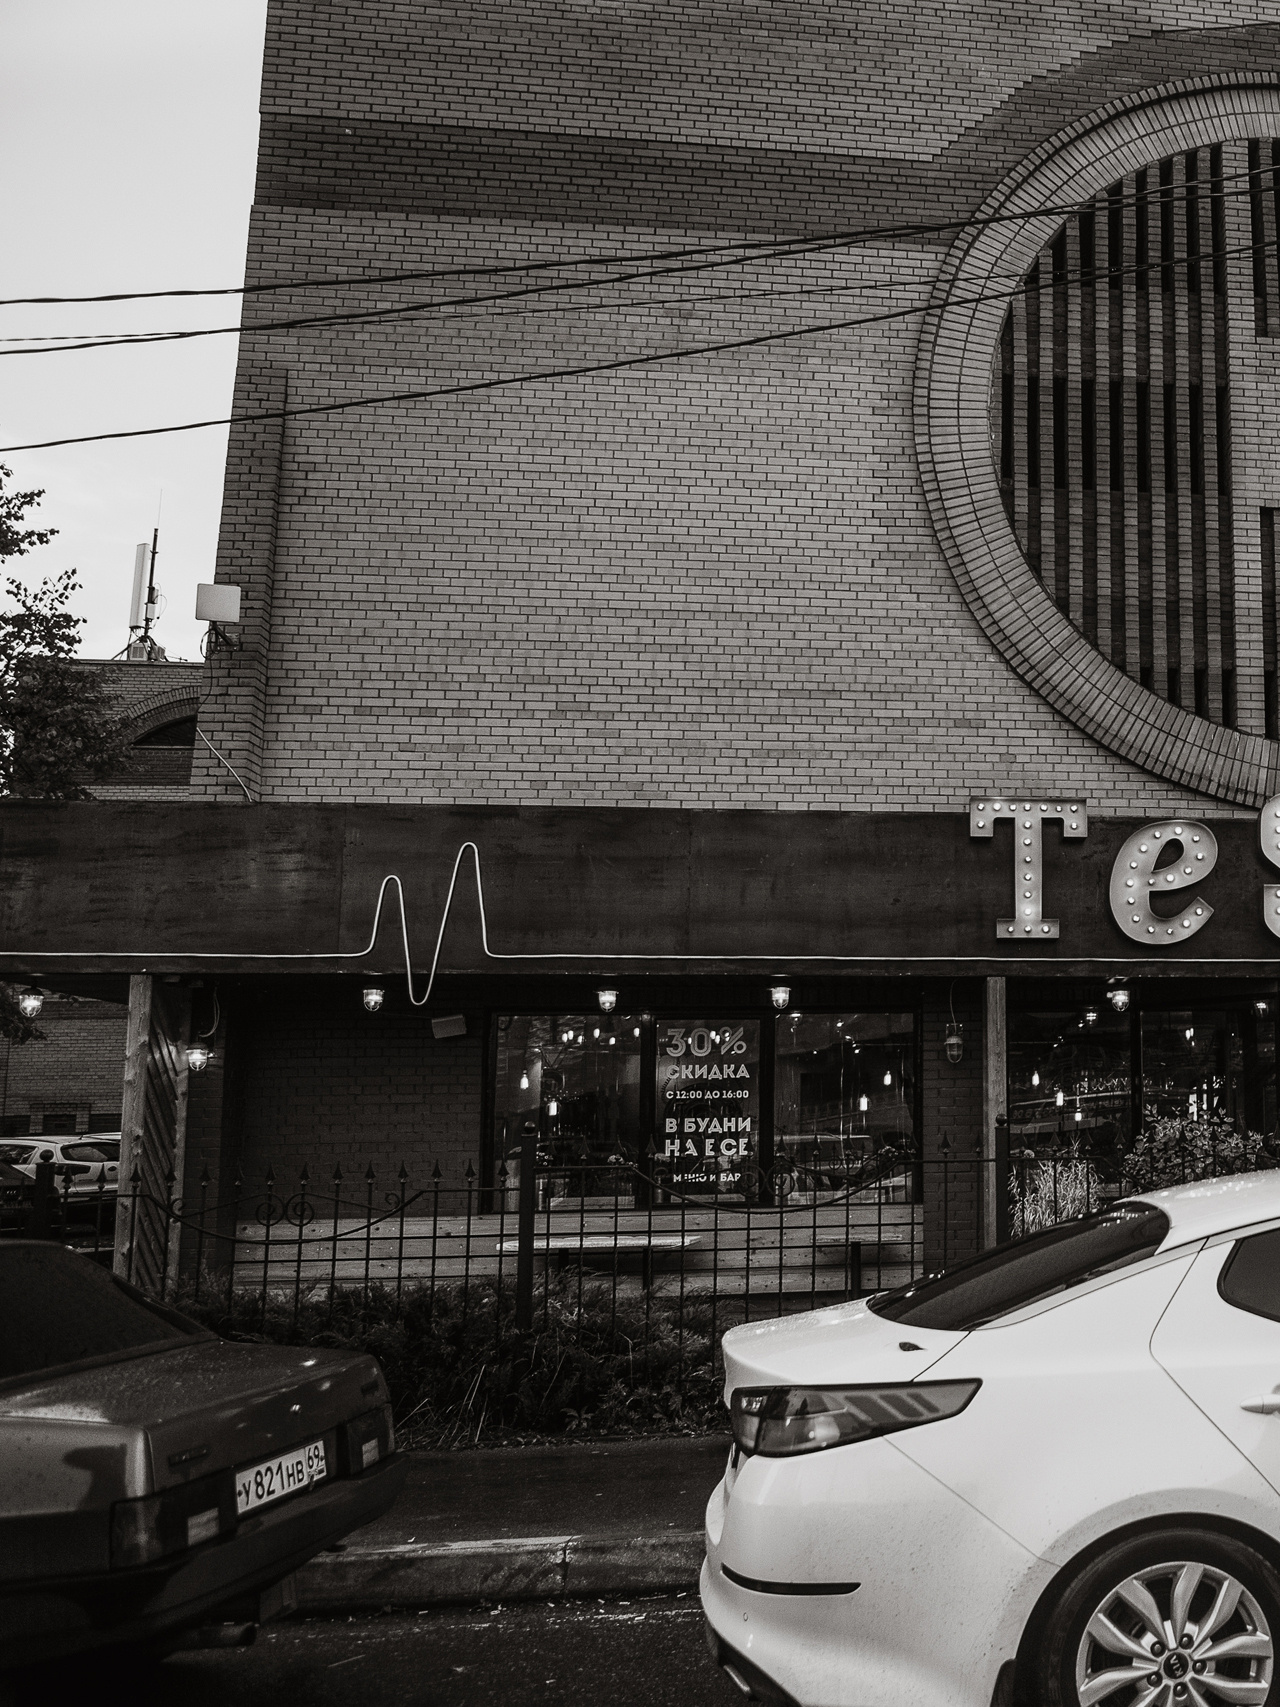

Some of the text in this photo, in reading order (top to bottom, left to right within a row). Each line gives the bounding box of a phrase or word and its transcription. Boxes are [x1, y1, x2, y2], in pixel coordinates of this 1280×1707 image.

[666, 1026, 747, 1057] 30%
[666, 1063, 750, 1080] СКИДКА
[666, 1090, 749, 1100] С 12:00 ДО 16:00
[665, 1117, 751, 1134] В БУДНИ
[665, 1138, 698, 1156] НА
[720, 1173, 741, 1182] БАР
[307, 1445, 320, 1470] 69
